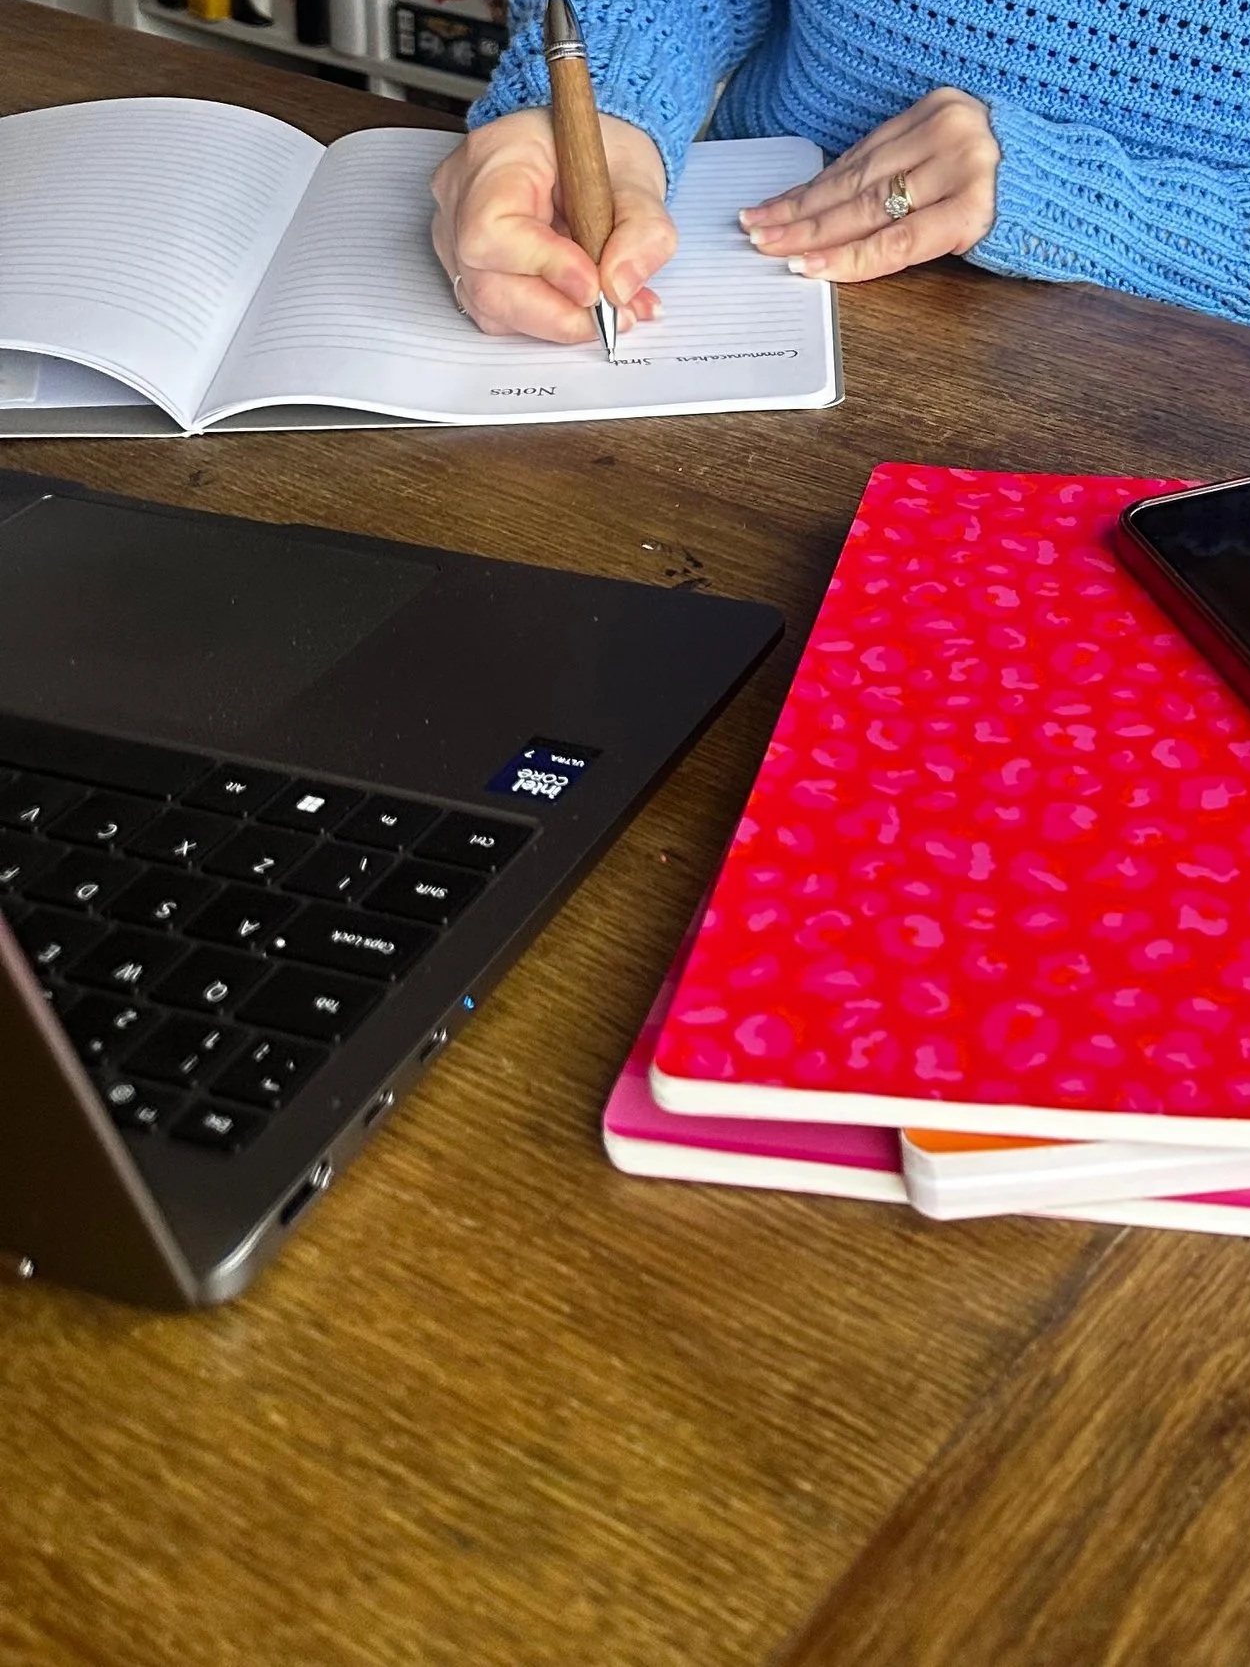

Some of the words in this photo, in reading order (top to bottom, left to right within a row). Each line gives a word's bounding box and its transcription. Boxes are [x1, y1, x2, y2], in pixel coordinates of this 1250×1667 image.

[490, 386, 556, 397] Notes
[551, 754, 585, 768] ULTRA
[511, 778, 561, 800] intel
[380, 813, 398, 827] Fn
[469, 834, 495, 849] Ctrl
[415, 881, 448, 900] Shift
[363, 938, 395, 955] Caps
[313, 996, 340, 1015] Tab
